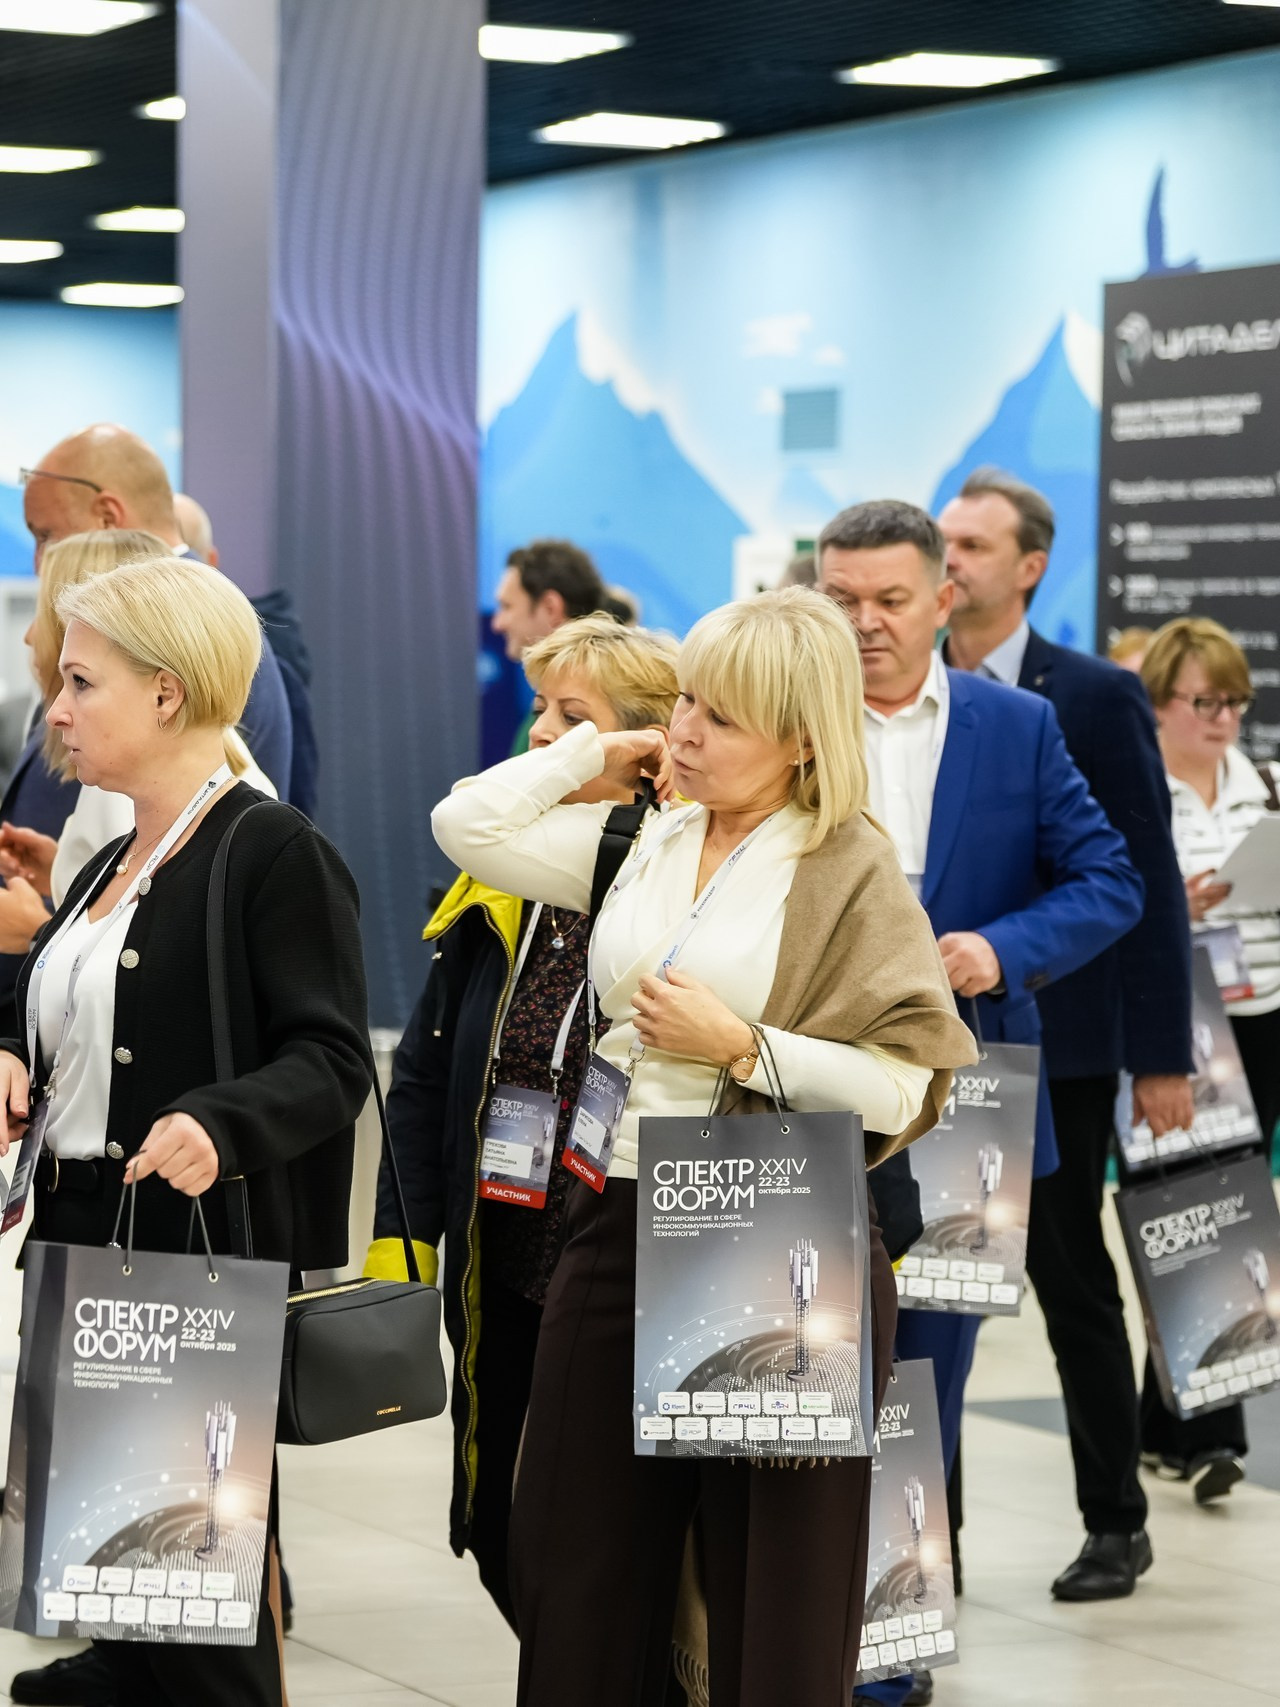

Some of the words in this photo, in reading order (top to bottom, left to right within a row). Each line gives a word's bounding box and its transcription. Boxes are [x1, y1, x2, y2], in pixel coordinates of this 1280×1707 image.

[587, 1066, 608, 1083] СПЕКТР
[585, 1075, 606, 1096] ФОРУМ
[958, 1074, 1000, 1093] XXIV
[490, 1097, 523, 1111] СПЕКТР
[489, 1106, 522, 1120] ФОРУМ
[570, 1157, 597, 1183] УЧАСТНИК
[653, 1158, 755, 1185] СПЕКТР
[759, 1158, 807, 1176] XXIV
[758, 1177, 790, 1187] 22-23
[486, 1186, 531, 1202] УЧАСТНИК
[653, 1184, 755, 1211] ФОРУМ
[758, 1187, 791, 1195] октября
[792, 1186, 811, 1194] 2025
[653, 1221, 754, 1229] ИНФОКОММУНИКАЦИОННЫХ
[1140, 1203, 1211, 1242] СПЕКТР
[653, 1229, 700, 1237] ТЕХНОЛОГИЙ
[1144, 1220, 1219, 1259] ФОРУМ
[74, 1297, 179, 1333] СПЕКТР
[182, 1306, 235, 1330] XXIV
[180, 1327, 215, 1341] 22-23
[73, 1327, 177, 1364] ФОРУМ
[180, 1341, 215, 1351] октября
[216, 1342, 237, 1352] 2025
[73, 1361, 132, 1374] РЕГУЛИРОВАНИЕ
[139, 1367, 162, 1375] СФЕРЕ
[880, 1403, 910, 1422] XXIV
[880, 1421, 900, 1433] 22-23
